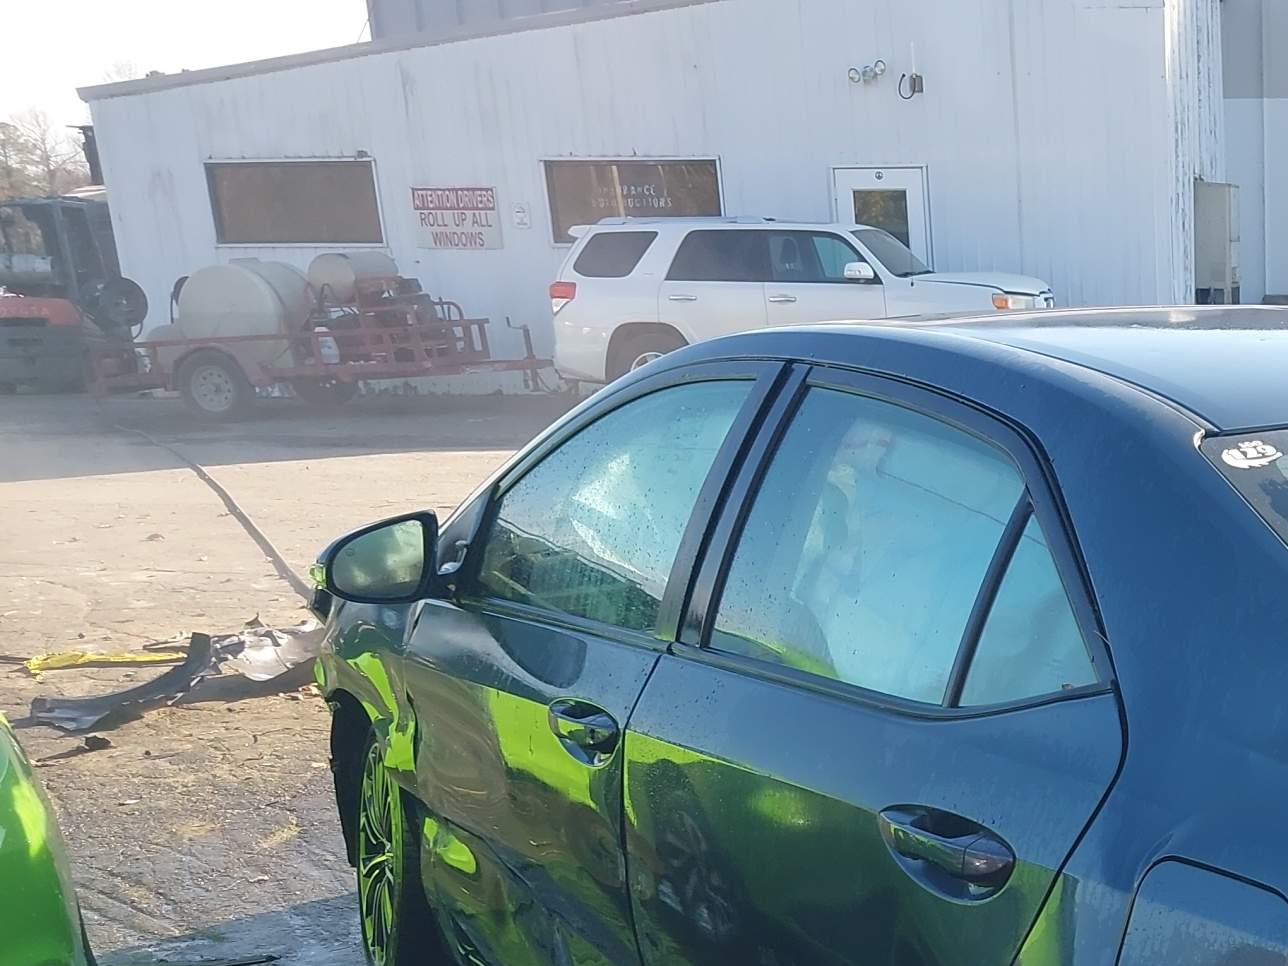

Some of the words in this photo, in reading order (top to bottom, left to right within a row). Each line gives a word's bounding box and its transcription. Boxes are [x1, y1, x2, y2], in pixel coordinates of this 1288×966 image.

[414, 190, 457, 208] ATTENTION
[458, 190, 494, 208] DRIVERS
[420, 212, 448, 227] ROLL
[453, 212, 467, 227] UP
[471, 212, 493, 227] ALL
[432, 231, 485, 247] WINDOWS
